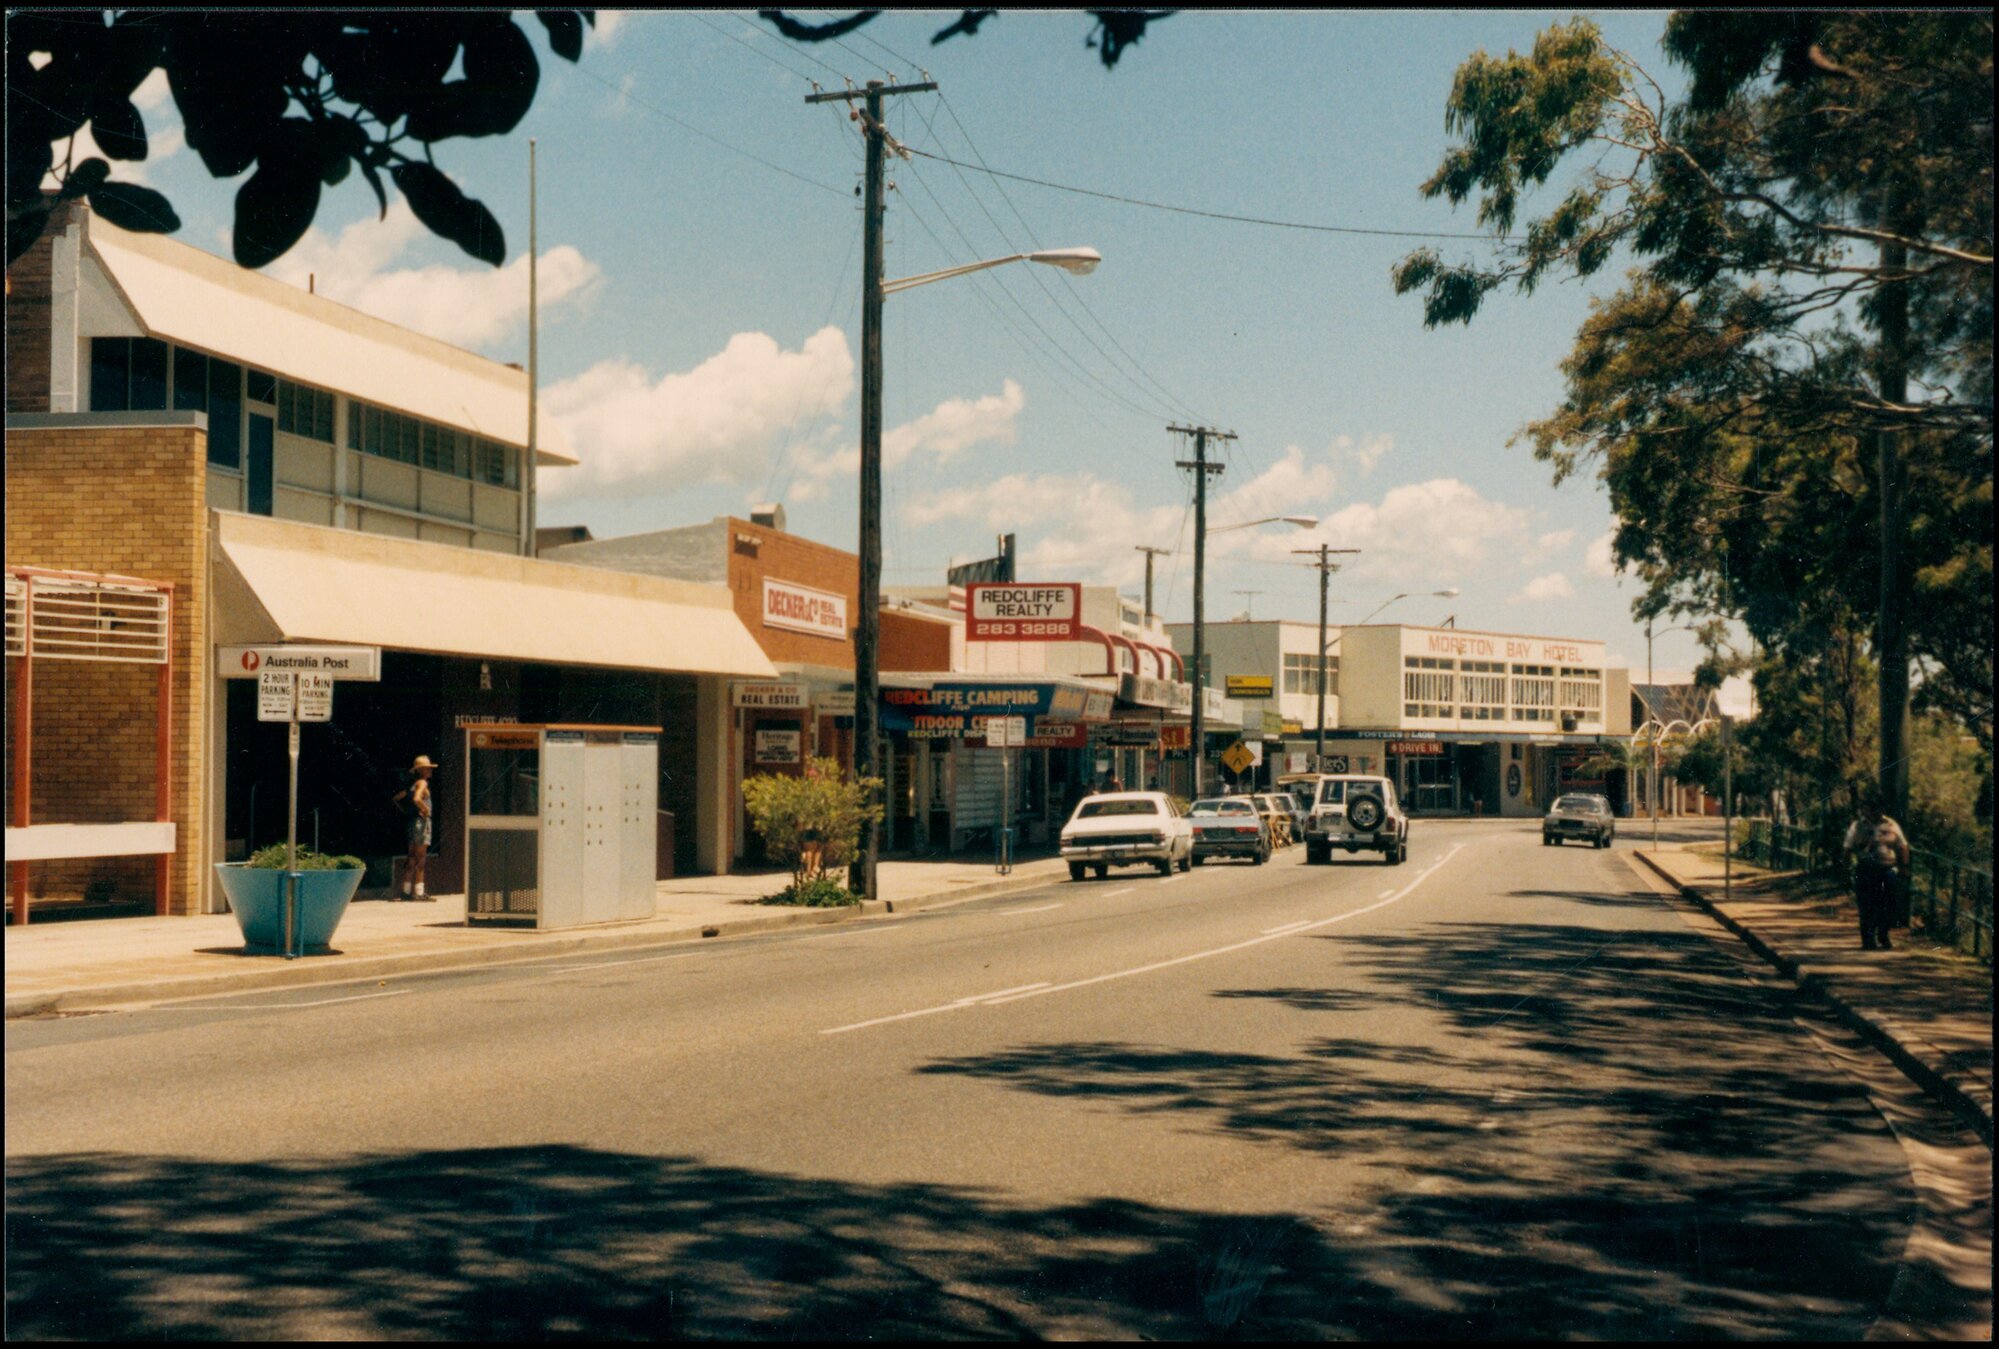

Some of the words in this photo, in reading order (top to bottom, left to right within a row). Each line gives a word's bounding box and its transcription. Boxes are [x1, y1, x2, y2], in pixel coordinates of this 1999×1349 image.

[982, 590, 1065, 603] REDCLIFFE
[768, 588, 805, 619] DECKER
[820, 600, 836, 614] REAL
[996, 604, 1053, 616] REALTY
[820, 614, 843, 628] ESTATE
[976, 623, 1016, 634] 283
[1021, 623, 1070, 634] 3288
[1429, 635, 1495, 656] MORETON
[1506, 641, 1531, 658] BAY
[1543, 644, 1583, 662] HOTEL
[265, 656, 318, 668] Australia
[323, 656, 349, 669] Post
[263, 673, 269, 683] 2
[271, 674, 289, 683] HOUR
[301, 679, 310, 688] 10
[313, 679, 330, 689] MIN
[261, 685, 291, 696] PARKING
[302, 690, 328, 698] PARKING
[741, 694, 764, 705] REAL
[768, 695, 800, 705] ESTATE
[885, 690, 963, 705] REDCLIFFE
[967, 689, 1039, 705] CAMPING
[907, 730, 960, 738] REDCLIFFE
[1037, 726, 1072, 736] REALTY
[1399, 743, 1424, 752] DRIVE
